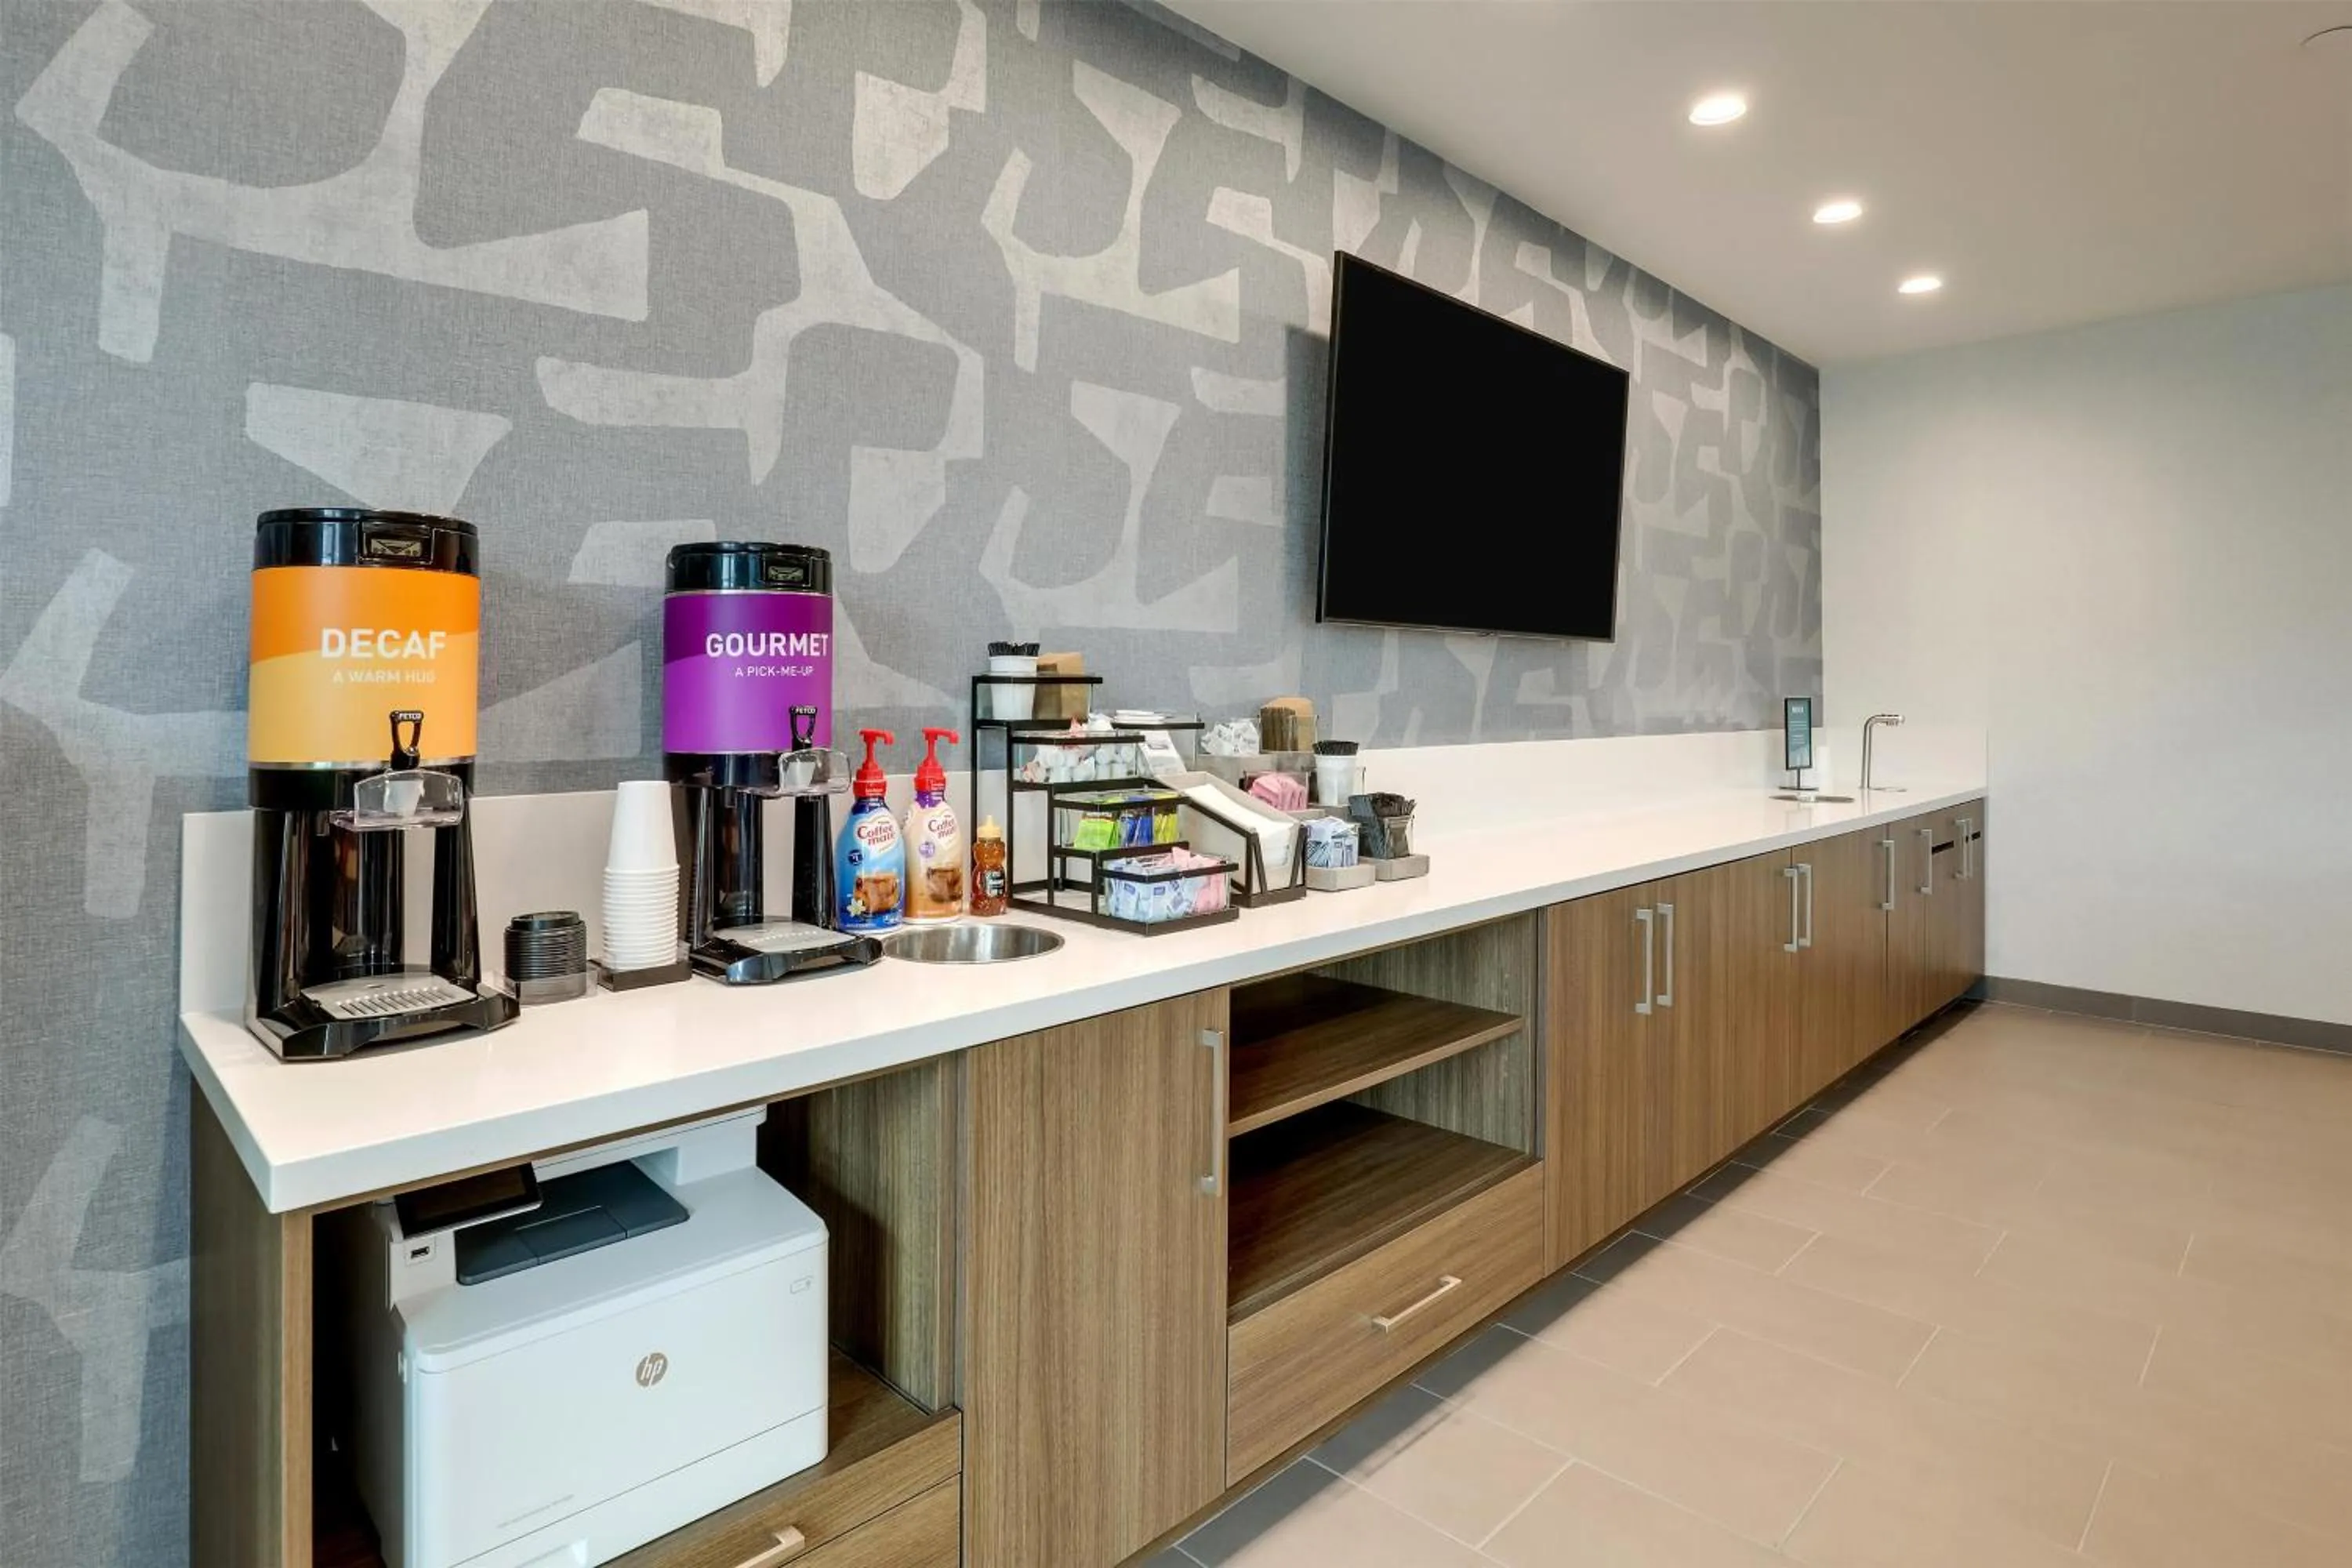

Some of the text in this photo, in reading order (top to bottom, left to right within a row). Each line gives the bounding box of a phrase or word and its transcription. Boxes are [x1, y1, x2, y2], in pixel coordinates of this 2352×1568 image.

[321, 628, 447, 659] DECAF
[706, 633, 829, 657] GOURMET
[333, 670, 437, 684] A WARM HUG
[735, 666, 813, 677] A PICK-ME-UP
[857, 825, 894, 840] Coffee
